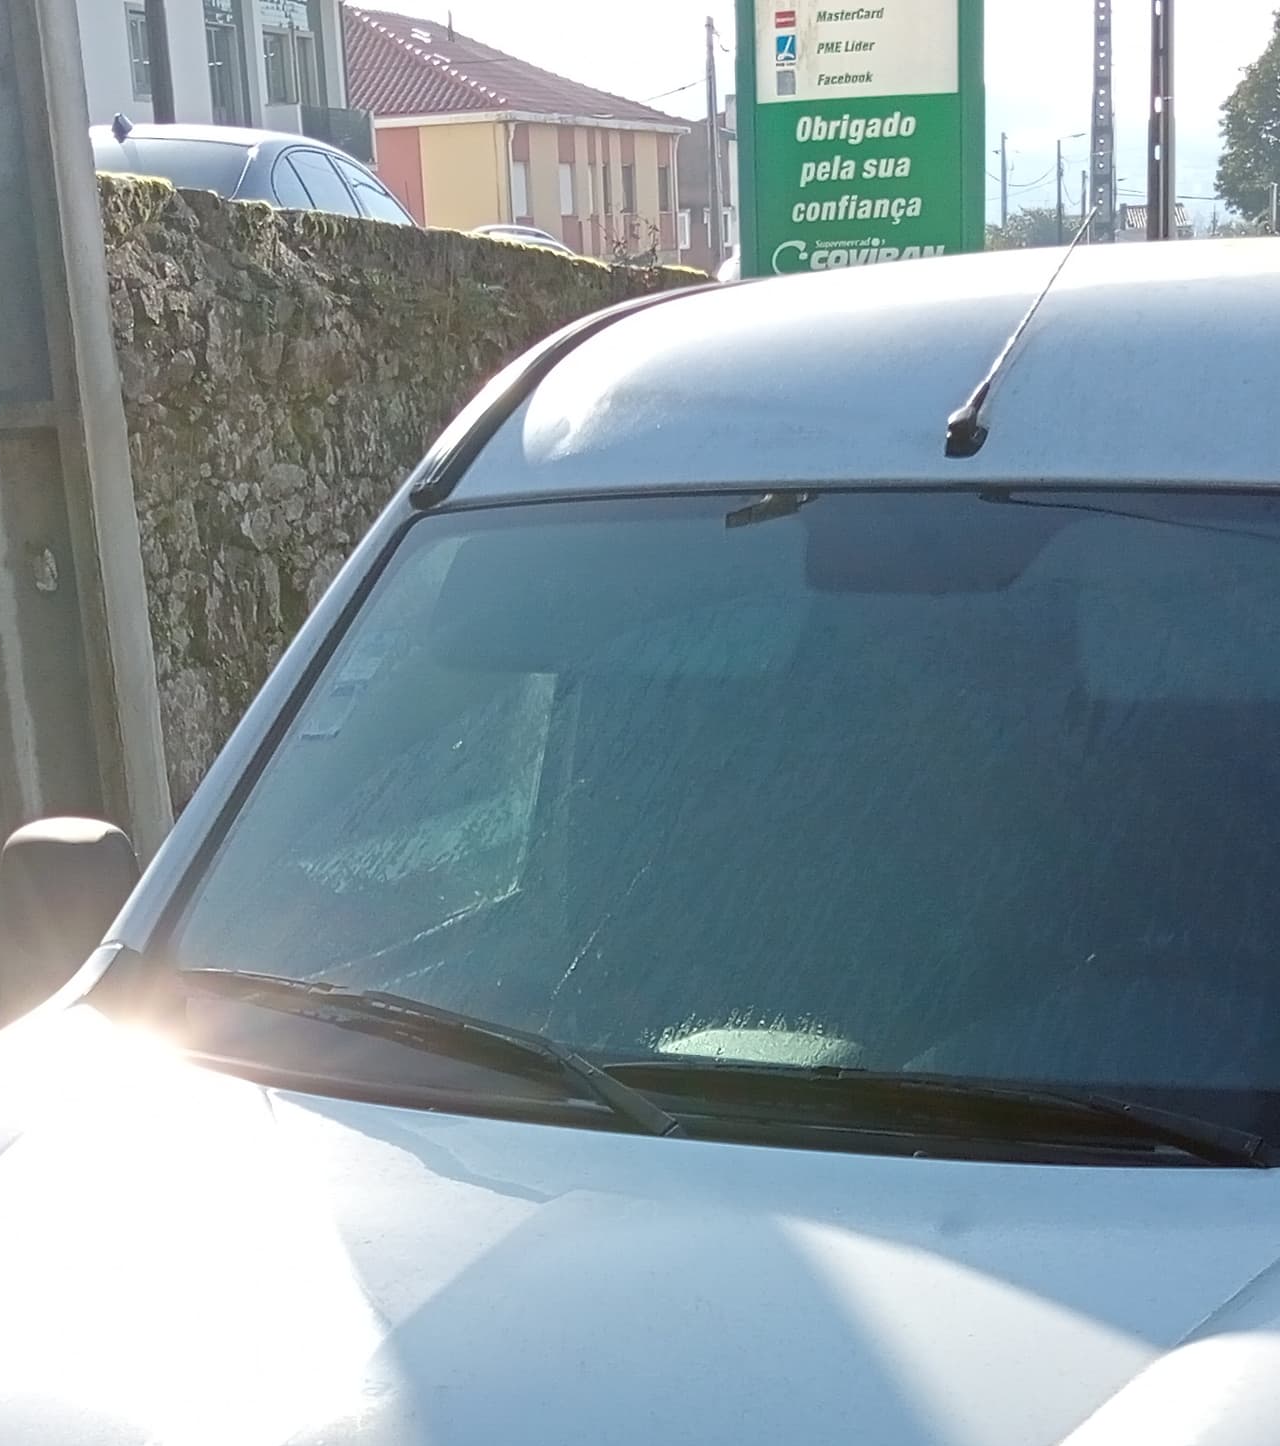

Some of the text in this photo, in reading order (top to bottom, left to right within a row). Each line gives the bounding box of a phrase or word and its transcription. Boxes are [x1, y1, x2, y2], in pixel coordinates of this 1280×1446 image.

[816, 8, 885, 23] MasterCard
[817, 41, 842, 54] PME
[817, 71, 873, 86] Facebook
[796, 112, 916, 144] Obrigado
[800, 155, 911, 187] pela sua
[792, 195, 922, 224] confiança
